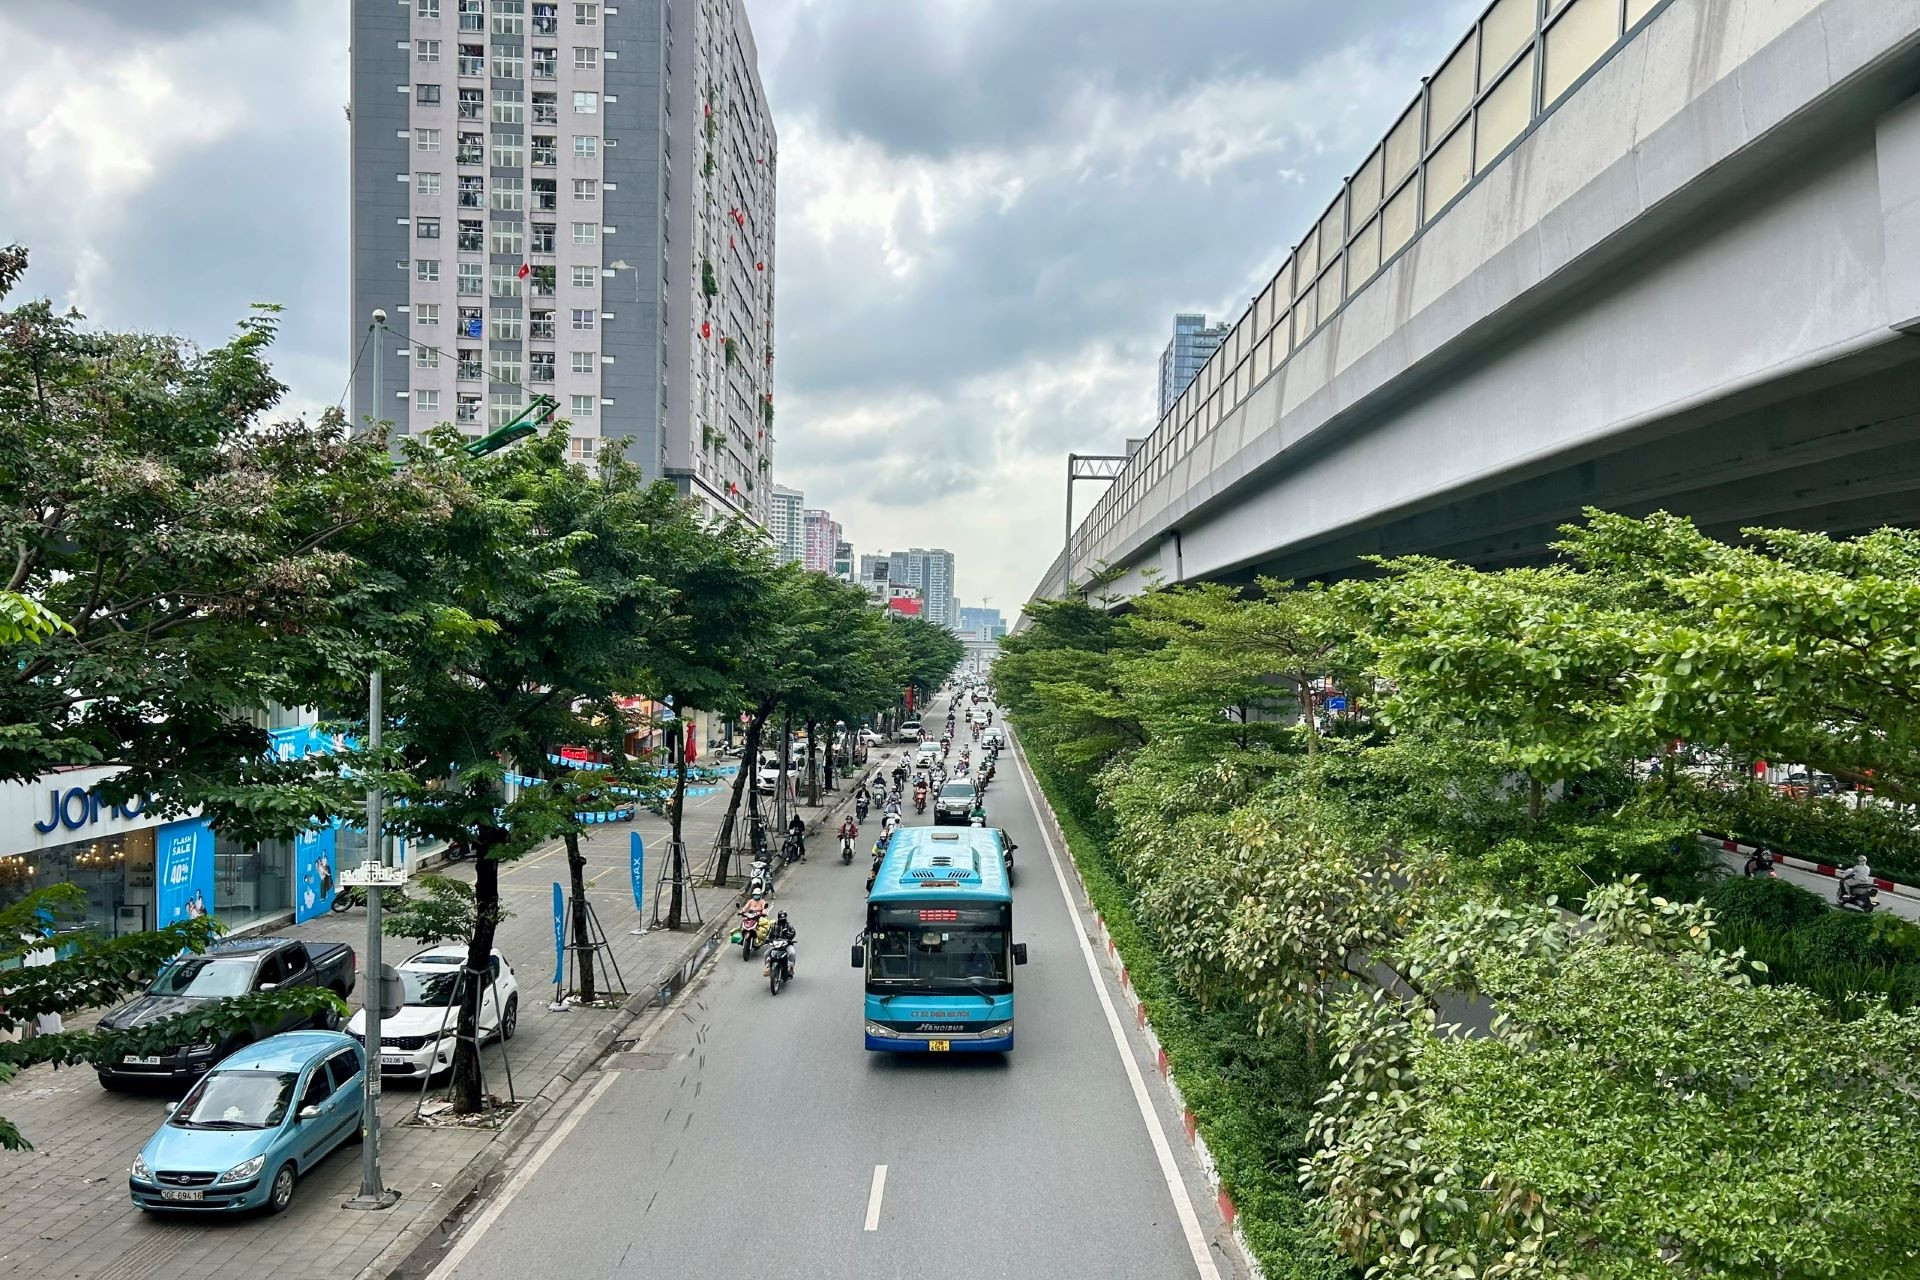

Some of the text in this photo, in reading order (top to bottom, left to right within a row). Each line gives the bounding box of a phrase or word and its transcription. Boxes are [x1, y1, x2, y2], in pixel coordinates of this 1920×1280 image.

[173, 835, 192, 846] FLASH
[172, 844, 191, 856] SALE
[915, 1023, 965, 1032] HANOIBUS
